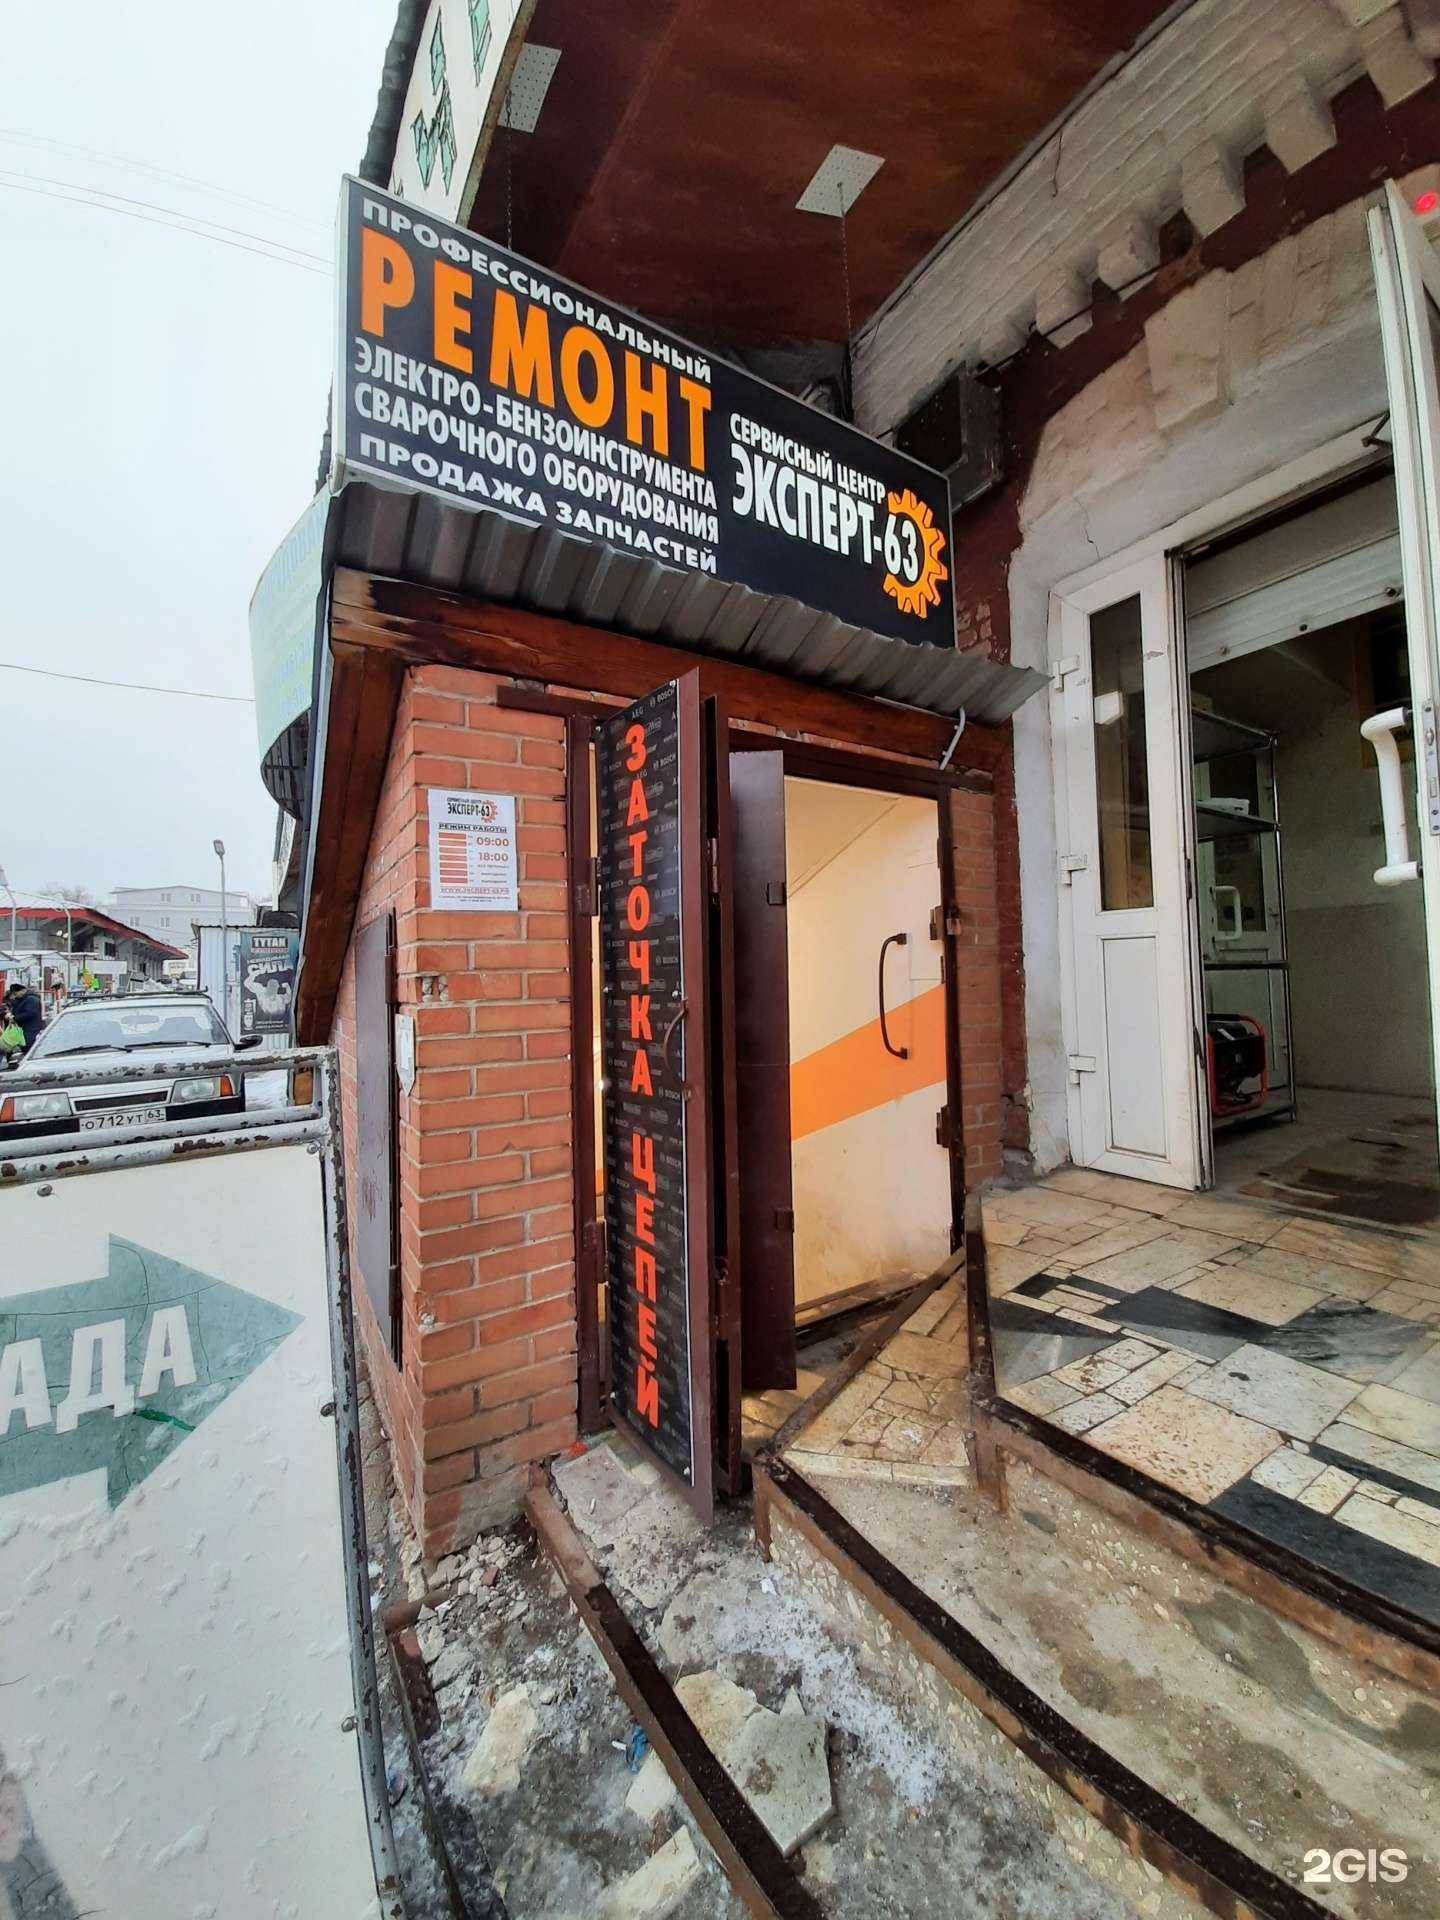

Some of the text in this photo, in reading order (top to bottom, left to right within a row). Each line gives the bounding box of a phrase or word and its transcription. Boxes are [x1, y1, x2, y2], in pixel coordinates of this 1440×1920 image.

[361, 226, 712, 472] РЕМОНТ
[363, 198, 711, 384] ПРОФЕССИОНАЛЬНЫЙ
[354, 382, 719, 545] СВАРОЧНОГО ОБОРУДОВАНИЯ
[360, 433, 717, 574] ПРОДАЖА ЗАПЧАСТЕЙ
[730, 412, 886, 504] СЕРВИСНЫЙ ЦЕНТР
[731, 443, 919, 583] ЭКСПЕРТ-63
[447, 802, 490, 817] ЭКСПЕРТ-63
[476, 837, 510, 847] 09:00
[479, 852, 509, 862] 18:00
[626, 723, 659, 1429] ЗАТОЧКА ЦЕПЕЙ
